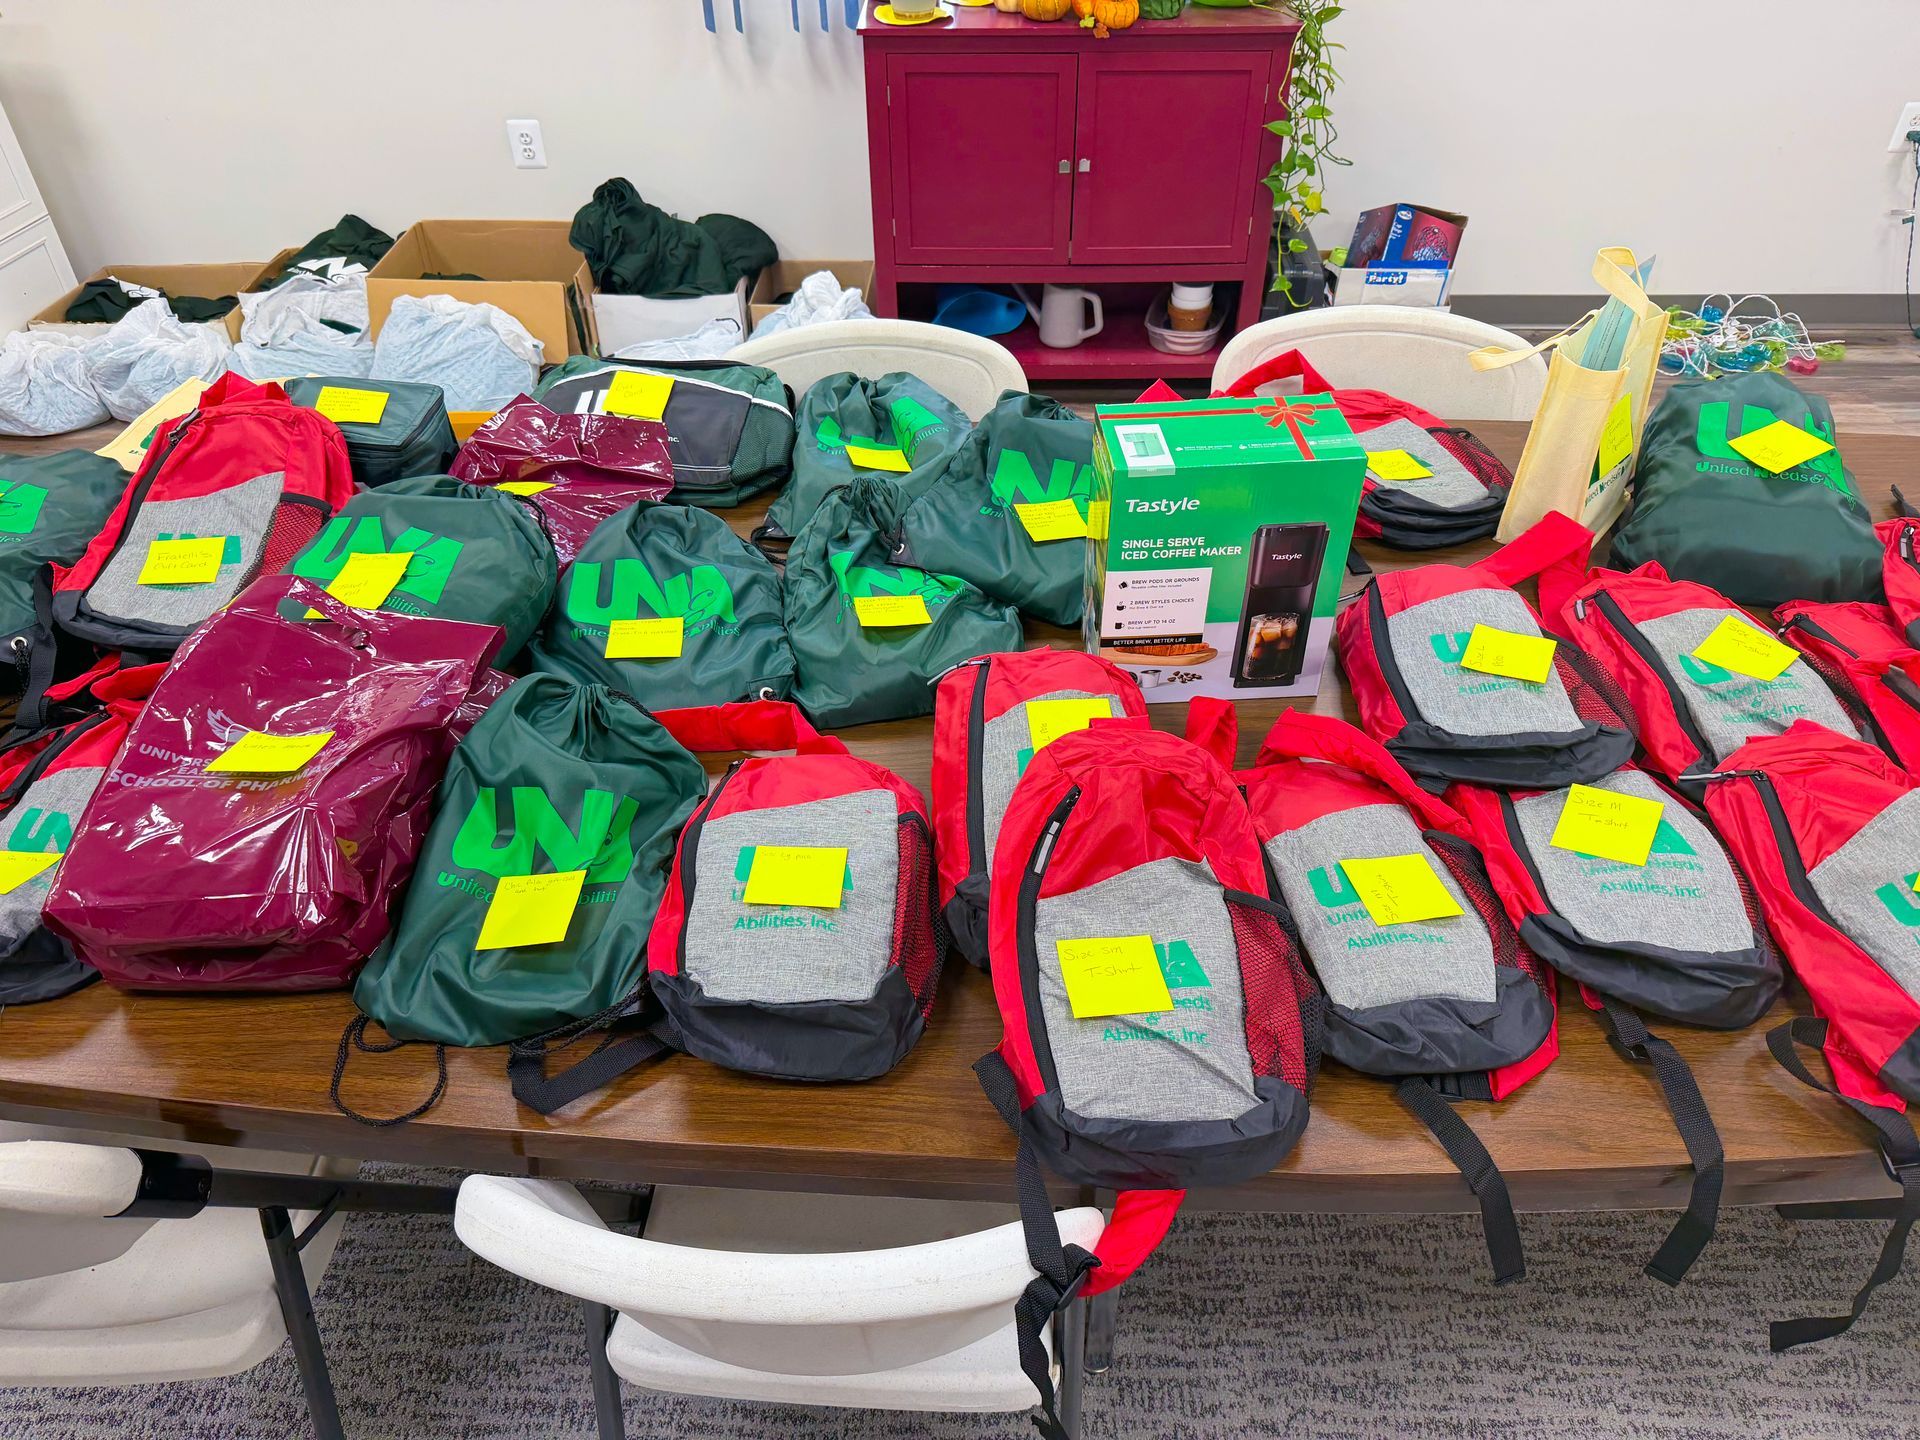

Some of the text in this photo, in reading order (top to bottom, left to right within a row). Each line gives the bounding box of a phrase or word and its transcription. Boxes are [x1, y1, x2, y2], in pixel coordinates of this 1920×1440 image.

[1696, 461, 1750, 476] United
[1125, 497, 1200, 515] Tastyle
[1122, 536, 1205, 549] SINGLE SERVE
[1121, 546, 1242, 560] ICED COFFEE MAKER
[1271, 553, 1303, 561] Tastyle
[202, 780, 234, 790] OF
[1572, 792, 1603, 808] Size
[1063, 948, 1095, 961] Size
[1174, 997, 1214, 1012] eeds
